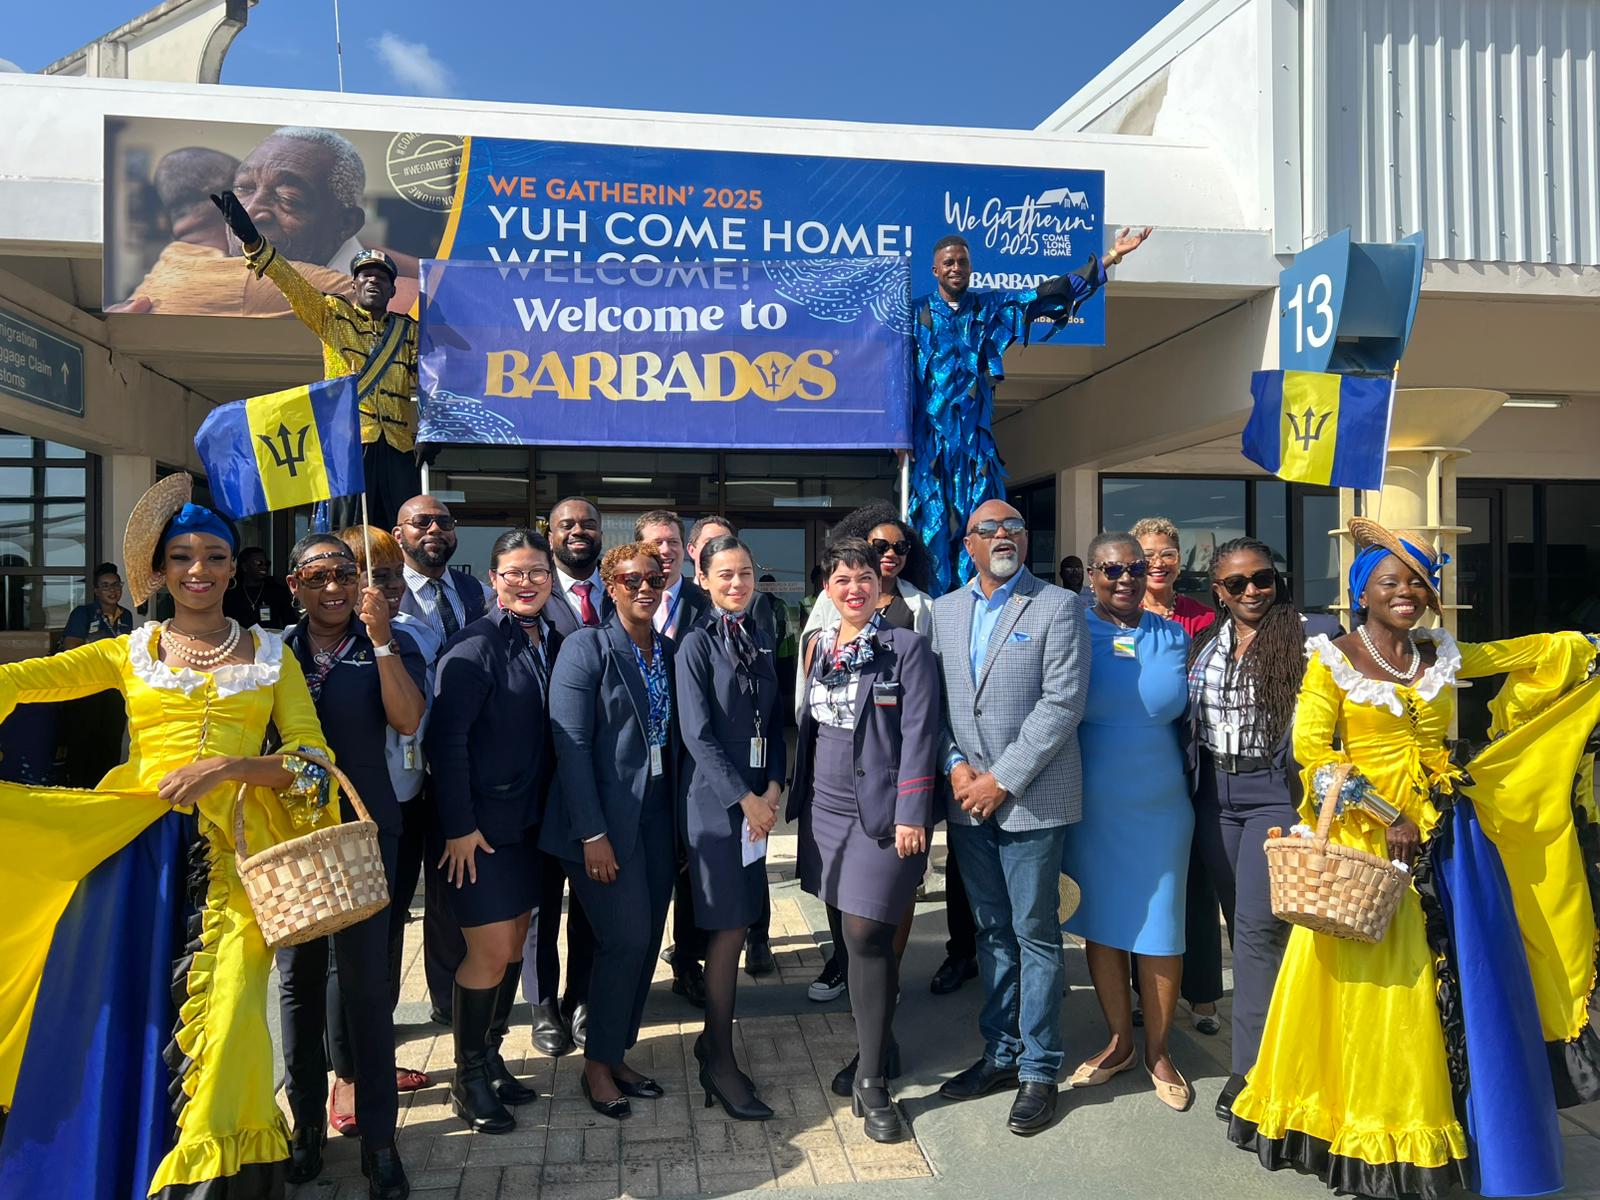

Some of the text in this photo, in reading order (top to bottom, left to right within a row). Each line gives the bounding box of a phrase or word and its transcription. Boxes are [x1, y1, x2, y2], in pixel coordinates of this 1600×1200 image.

[487, 175, 763, 210] WE GATHERIN’ 2025
[944, 190, 981, 232] We
[487, 205, 912, 257] YUH COME HOME!
[1000, 231, 1039, 255] 2025
[1042, 233, 1070, 242] COME
[487, 246, 750, 291] WELCOME!
[1043, 248, 1072, 257] HOME
[968, 271, 1061, 290] BARBAD
[512, 296, 787, 333] Welcome to
[1288, 273, 1334, 353] 13
[28, 354, 53, 377] Claim
[484, 348, 837, 402] BARBADOS
